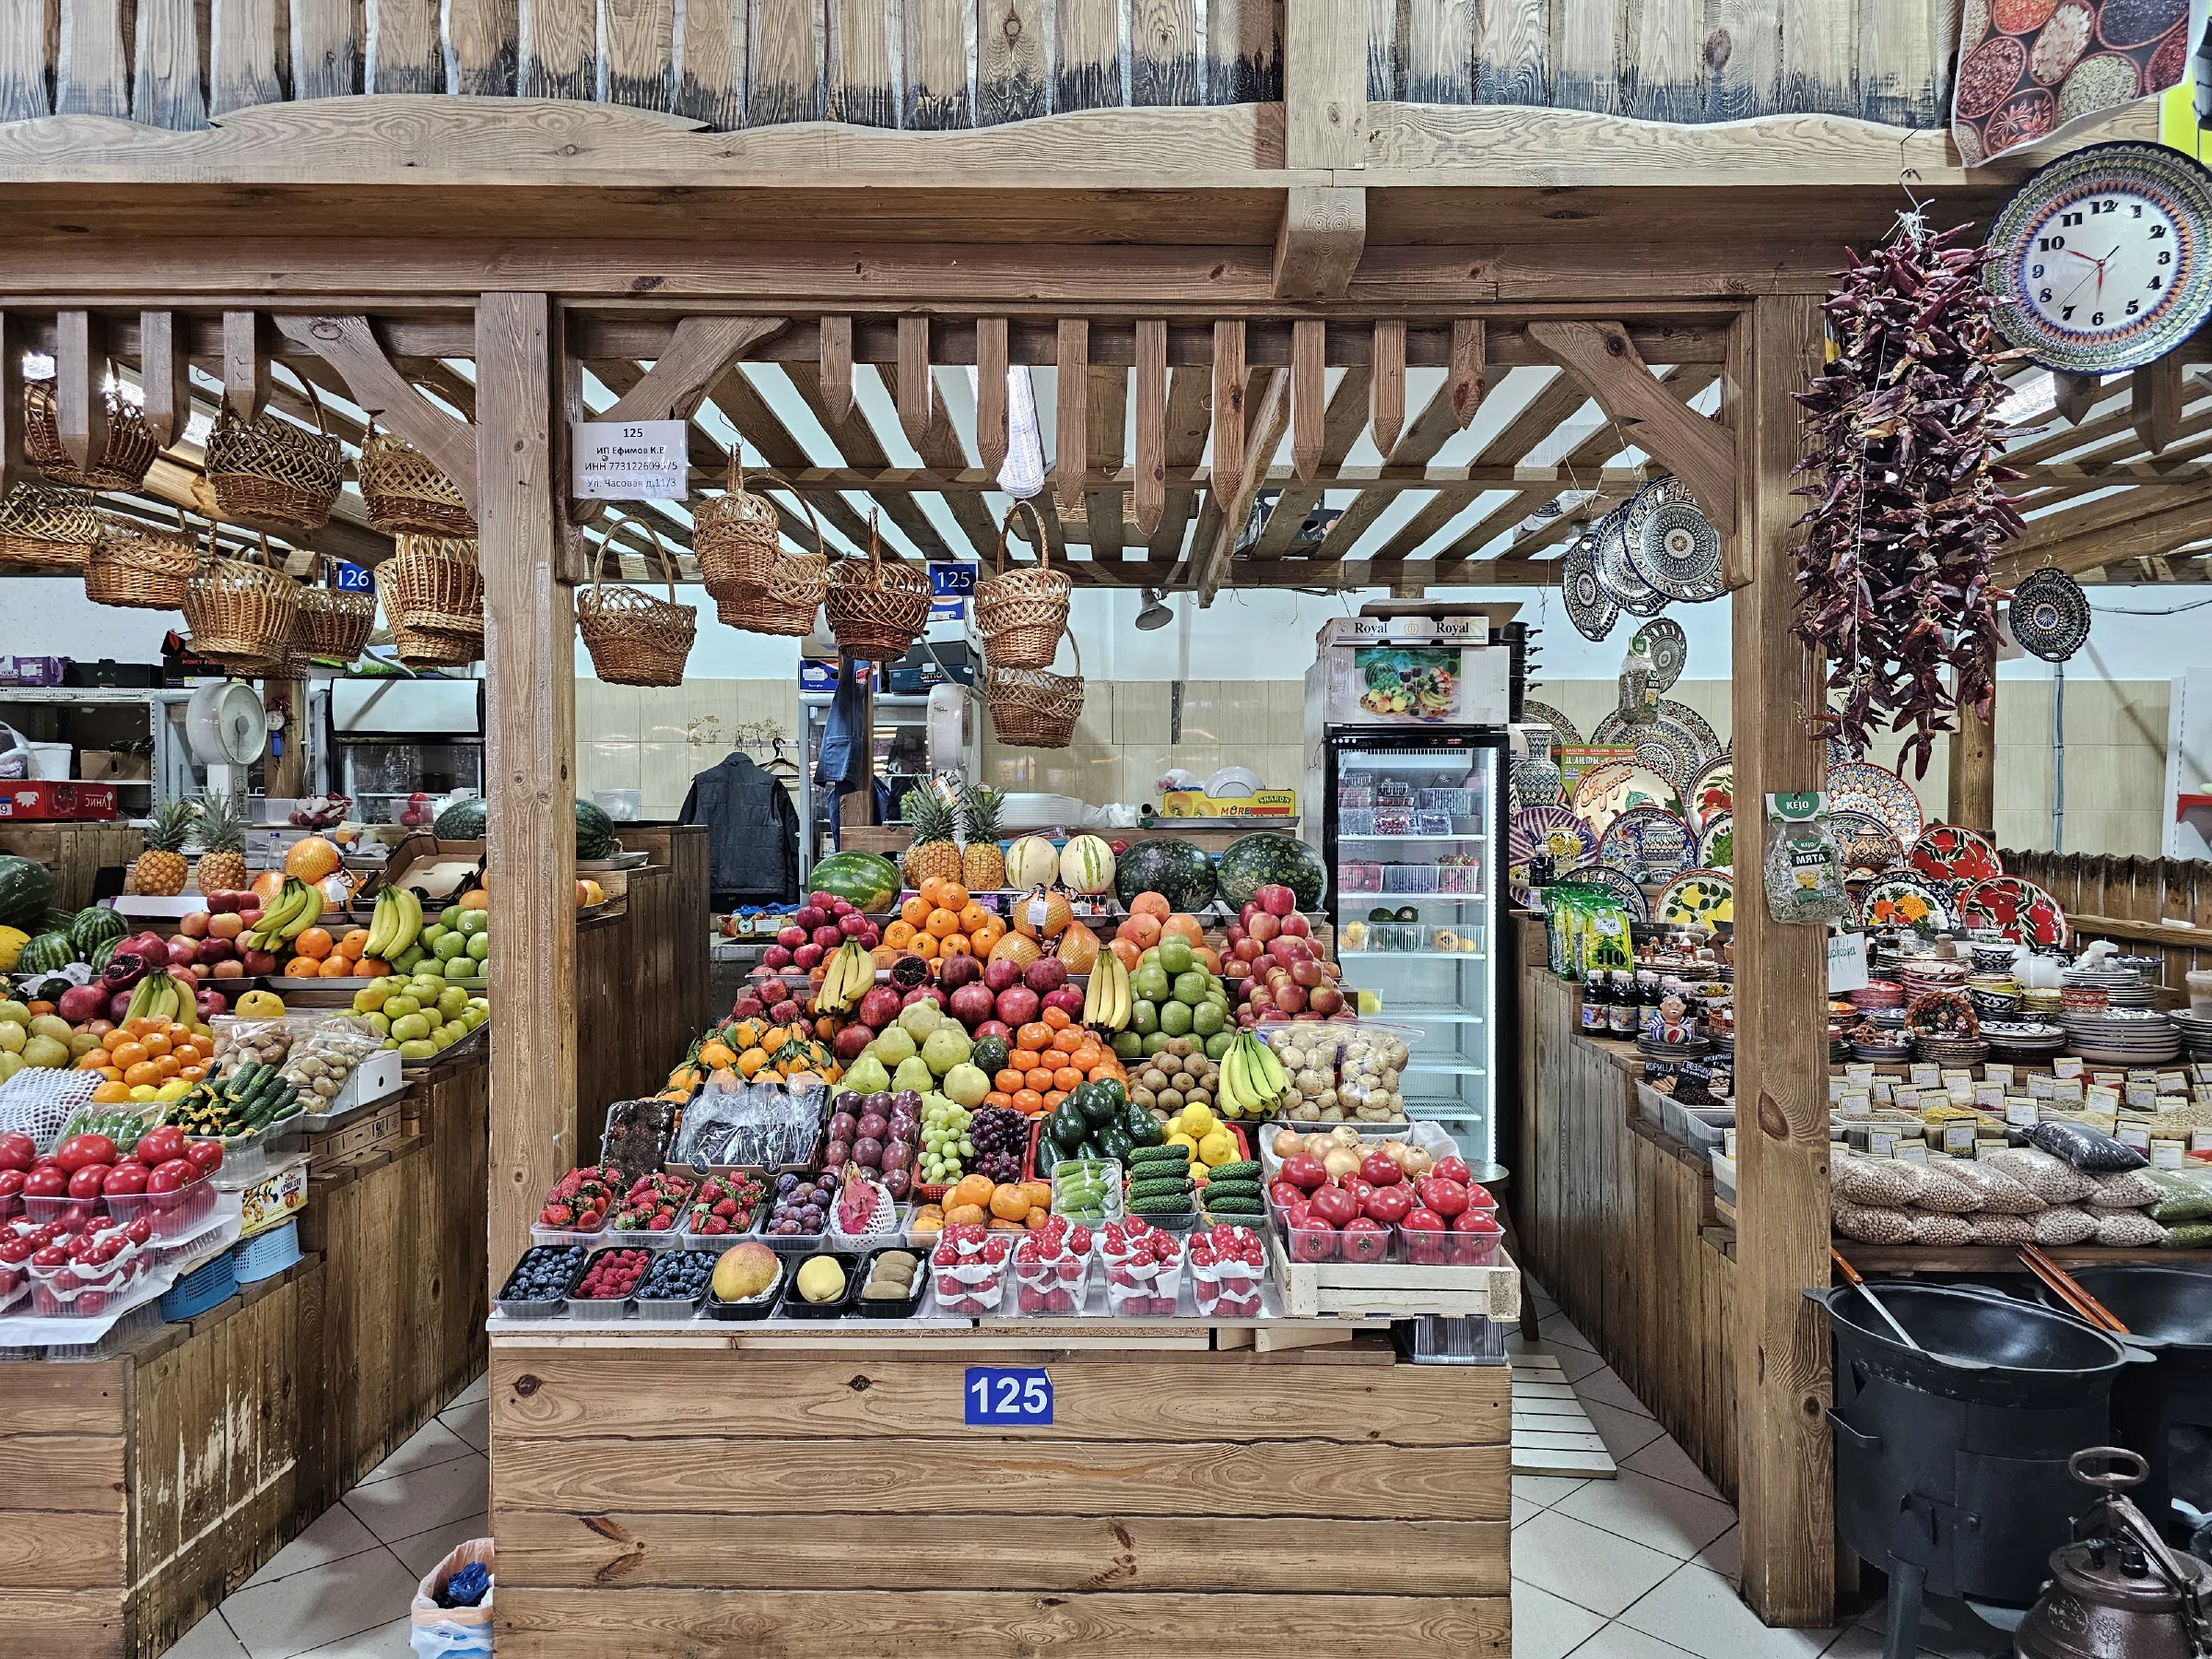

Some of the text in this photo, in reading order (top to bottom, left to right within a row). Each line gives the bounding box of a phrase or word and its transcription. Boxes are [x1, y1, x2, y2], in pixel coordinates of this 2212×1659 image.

[2088, 199, 2119, 215] 12
[2130, 205, 2142, 218] 1
[2060, 212, 2083, 227] 11
[2147, 225, 2167, 240] 2
[2038, 235, 2065, 252] 10
[2157, 251, 2171, 265] 3
[2031, 264, 2044, 278] 9
[2146, 276, 2162, 289] 4
[2039, 288, 2053, 303] 8
[2062, 305, 2077, 321] 7
[2125, 299, 2139, 315] 5
[2091, 312, 2104, 326] 6
[623, 428, 643, 438] 125
[612, 446, 648, 455] Ефимов
[585, 463, 606, 471] ИНН
[587, 477, 677, 488] Ул. Часовая д.11/3
[337, 570, 370, 587] 126
[937, 571, 971, 588] 125
[1355, 622, 1469, 636] Royal Royal
[920, 672, 942, 680] amo
[1258, 795, 1291, 804] SHARON
[1786, 801, 1809, 811] KEJO
[1795, 853, 1826, 865] МЯТА
[1645, 1062, 1675, 1073] КОРИЦА
[280, 1177, 302, 1194] APRICOT
[971, 1377, 1048, 1414] 125
